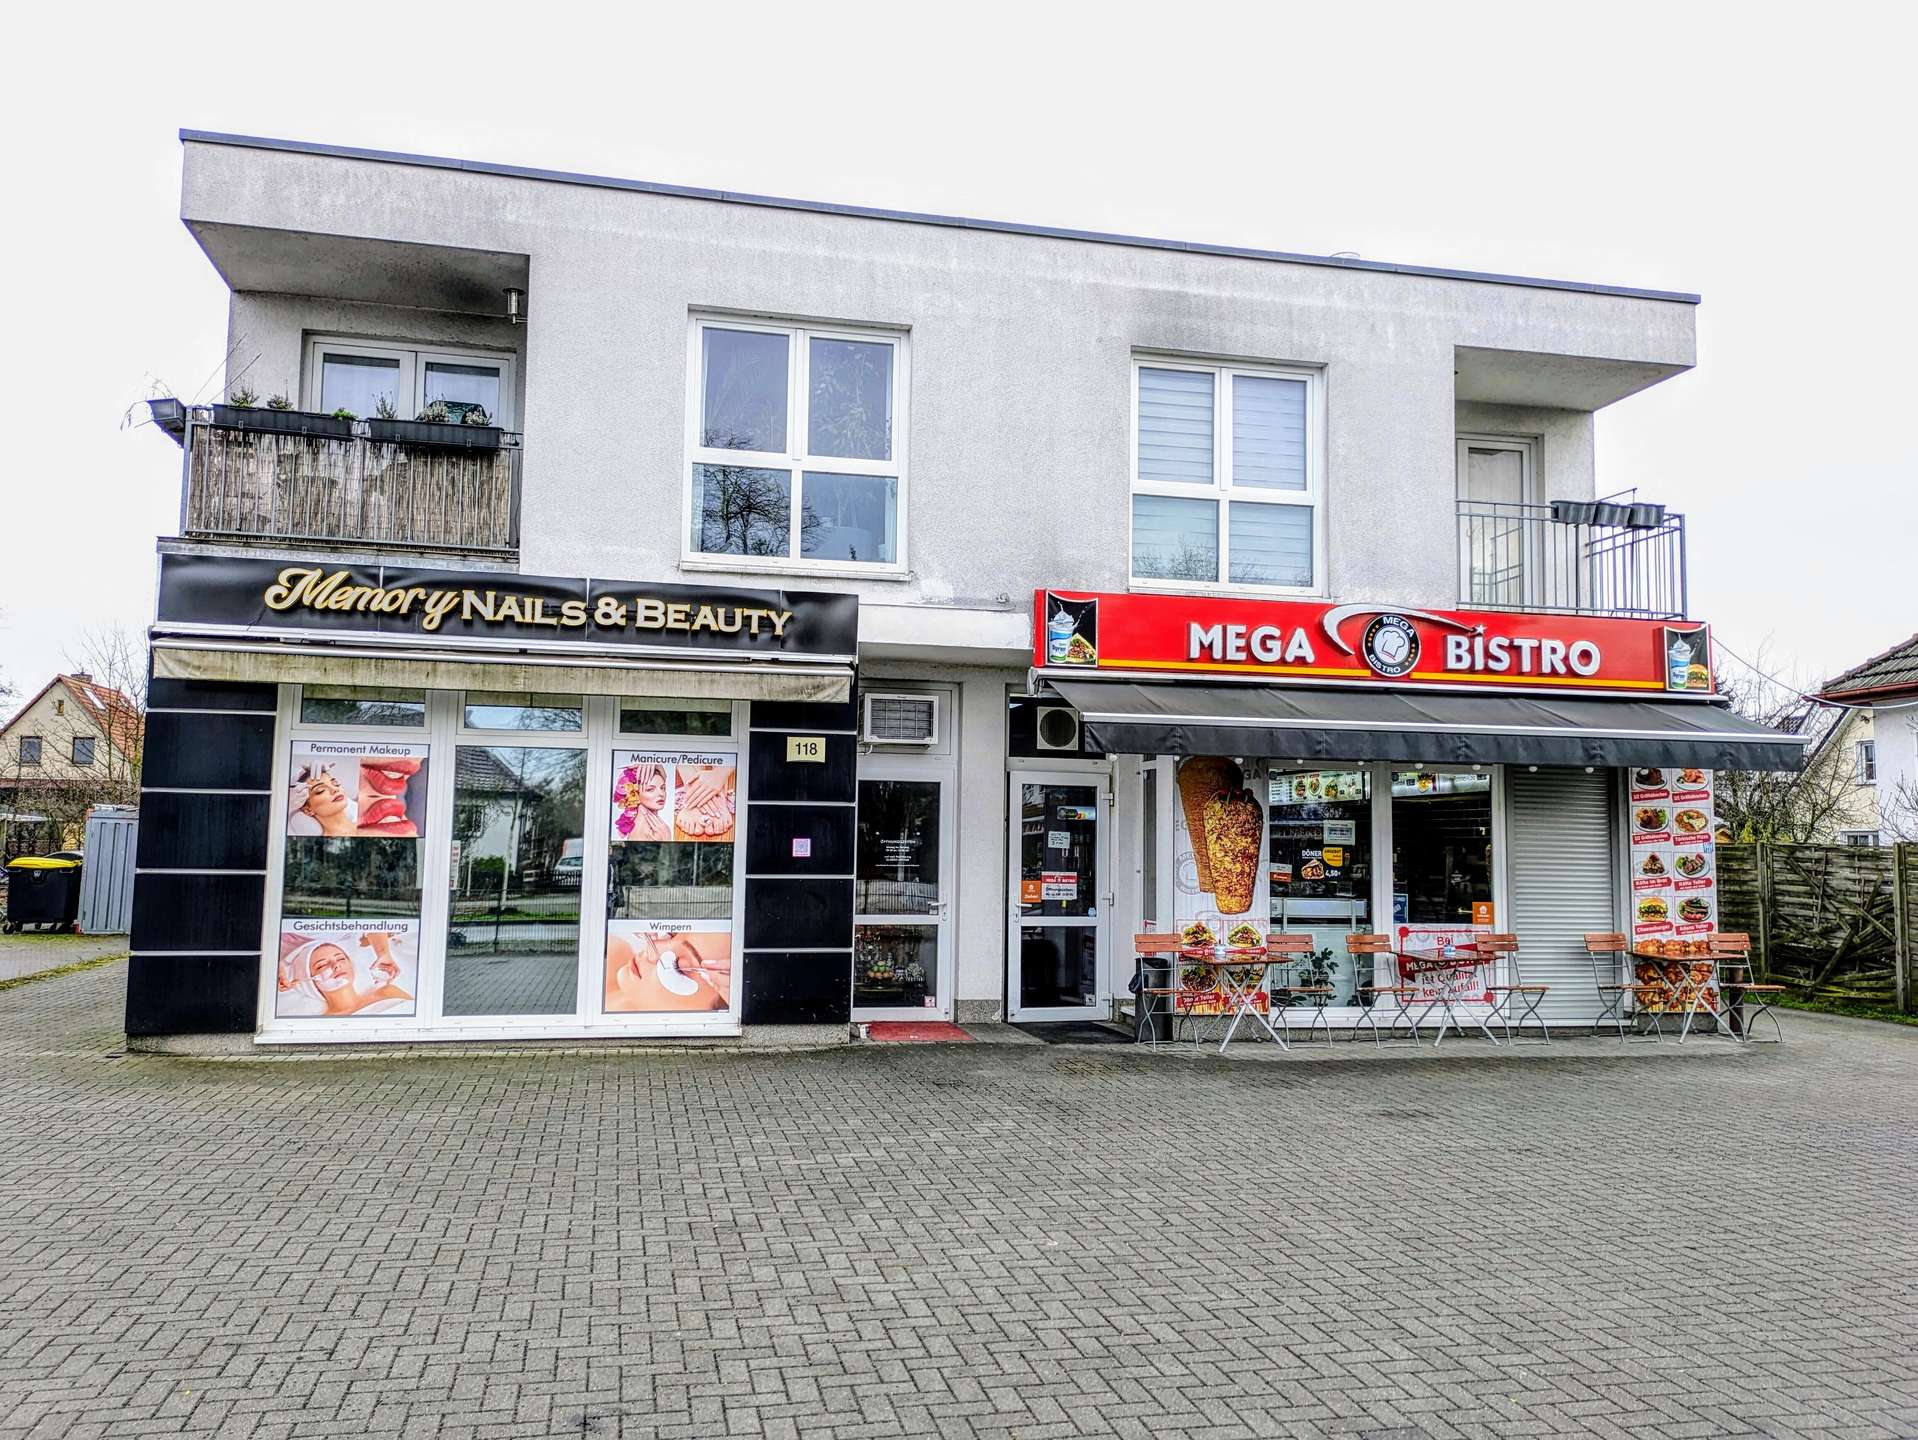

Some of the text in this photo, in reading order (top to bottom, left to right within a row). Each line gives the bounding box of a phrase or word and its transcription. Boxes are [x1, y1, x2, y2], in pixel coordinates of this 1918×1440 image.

[264, 567, 793, 636] Memory NAILS & BEAUTY
[1383, 616, 1415, 638] MEGA
[1188, 622, 1316, 664] MEGA
[1368, 653, 1402, 674] BISTRO
[310, 743, 411, 757] Permanent Makeup
[795, 742, 818, 756] 118
[630, 753, 724, 766] Manicure/Pedicure
[1301, 848, 1322, 857] DÖNER
[293, 920, 409, 933] Gesichtsbehandlung
[649, 922, 692, 932] Wimpern
[1436, 936, 1454, 946] Bei
